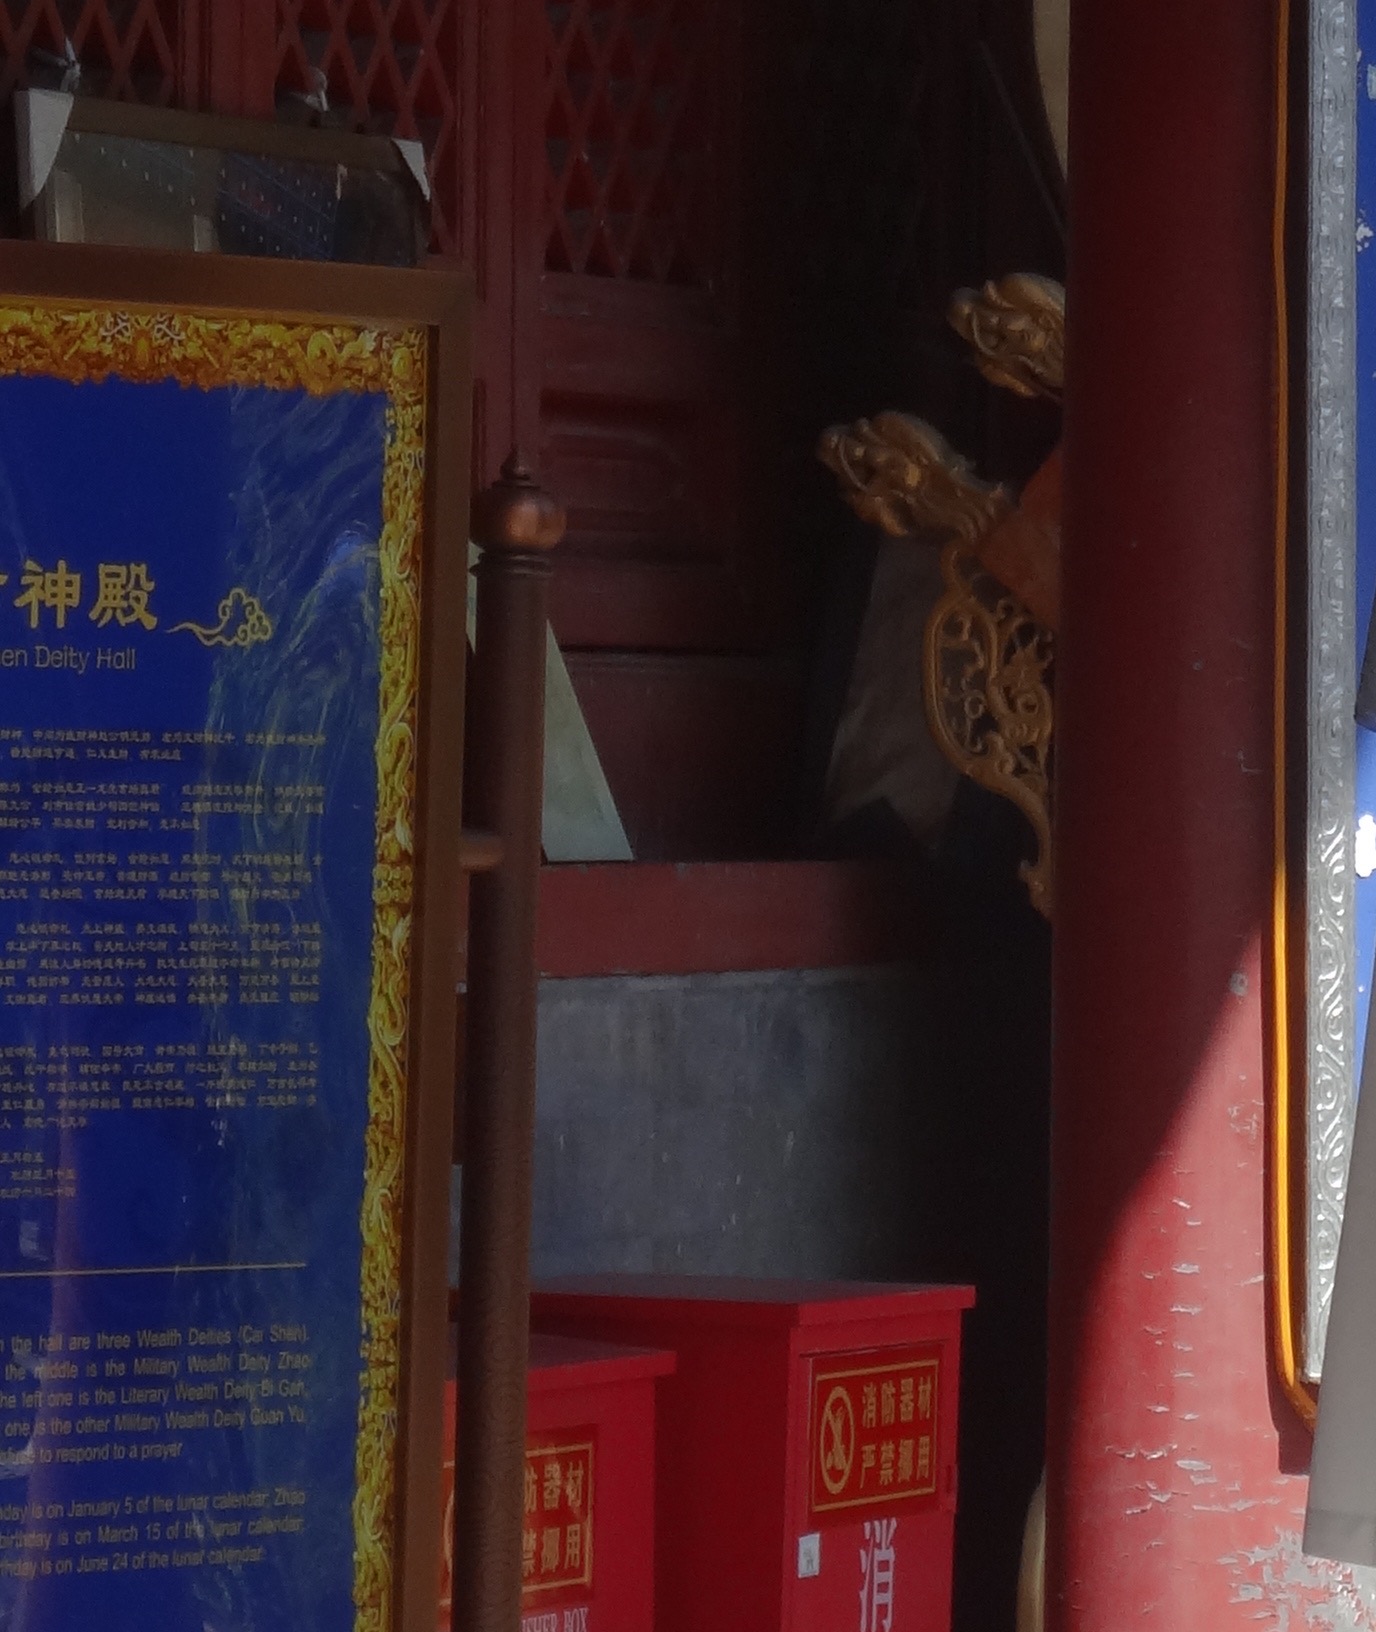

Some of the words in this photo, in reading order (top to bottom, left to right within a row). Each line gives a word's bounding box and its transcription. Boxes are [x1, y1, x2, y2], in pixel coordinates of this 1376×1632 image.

[0, 560, 158, 630] 神殿
[0, 649, 28, 667] en
[35, 646, 90, 674] Deity
[97, 648, 136, 670] Hall
[69, 1336, 90, 1350] are
[97, 1332, 130, 1349] three
[137, 1329, 182, 1347] Wealth
[86, 1363, 97, 1377] is
[105, 1359, 125, 1376] the
[134, 1357, 179, 1378] Military
[188, 1353, 230, 1372] Wealth
[48, 1393, 73, 1407] one
[79, 1390, 90, 1405] is
[95, 1388, 115, 1404] the
[121, 1386, 168, 1407] Literary
[175, 1381, 218, 1401] Wealth
[862, 1375, 932, 1429] 消防器材
[5, 1422, 30, 1437] one
[51, 1417, 72, 1435] the
[76, 1415, 110, 1433] other
[115, 1413, 160, 1433] Military
[165, 1410, 209, 1429] Wealth
[40, 1448, 52, 1463] to
[56, 1443, 110, 1464] respond
[113, 1443, 125, 1459] to
[860, 1435, 931, 1489] 严禁挪用
[47, 1504, 64, 1520] on
[68, 1499, 120, 1519] January
[137, 1495, 150, 1514] of
[153, 1495, 173, 1512] the
[177, 1495, 209, 1511] lunar
[75, 1530, 92, 1545] on
[98, 1525, 138, 1543] March
[166, 1520, 179, 1540] of
[55, 1557, 72, 1575] on
[77, 1555, 108, 1573] June
[112, 1552, 128, 1570] 24
[132, 1551, 146, 1570] of
[148, 1550, 168, 1568] the
